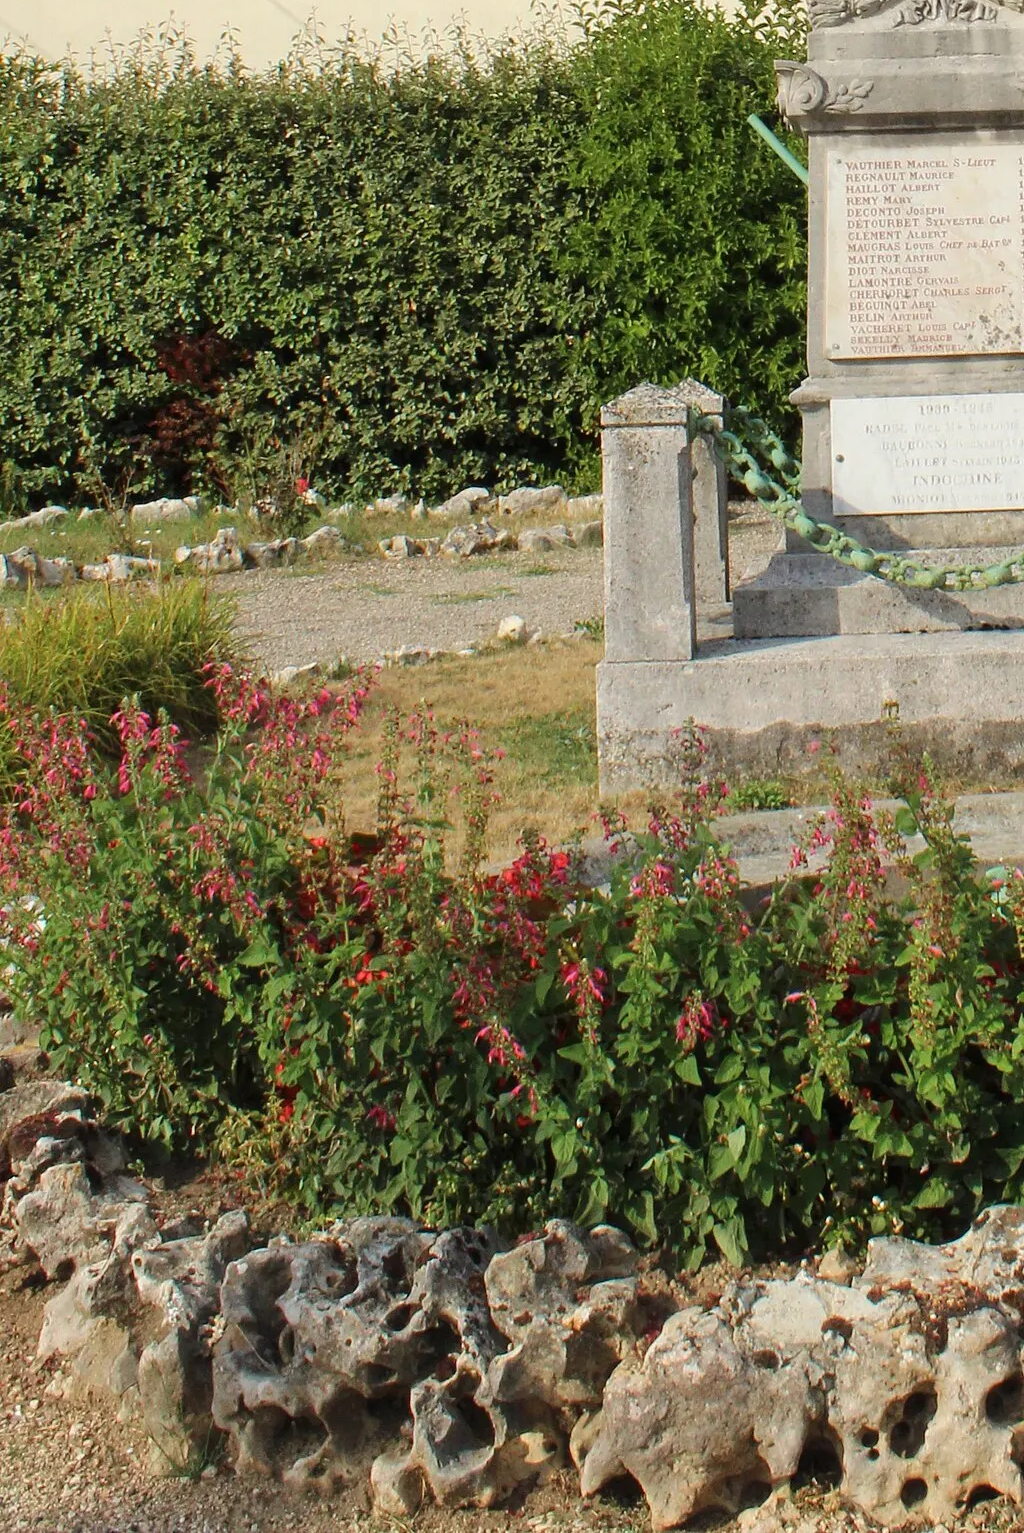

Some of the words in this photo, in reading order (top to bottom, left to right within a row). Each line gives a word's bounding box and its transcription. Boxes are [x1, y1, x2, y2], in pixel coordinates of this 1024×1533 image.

[845, 161, 901, 171] VAUTHIER
[845, 172, 905, 182] REGNAULT
[846, 184, 896, 194] HAILLOT
[846, 196, 878, 206] REMY
[847, 207, 901, 217] DECONTO
[848, 242, 900, 252] MAUGRAS
[848, 254, 901, 265] MAITROT
[848, 266, 877, 276] DIOT
[848, 277, 912, 288] LAMONTRE
[850, 313, 884, 323] BELIN
[851, 324, 911, 334] VACHERET
